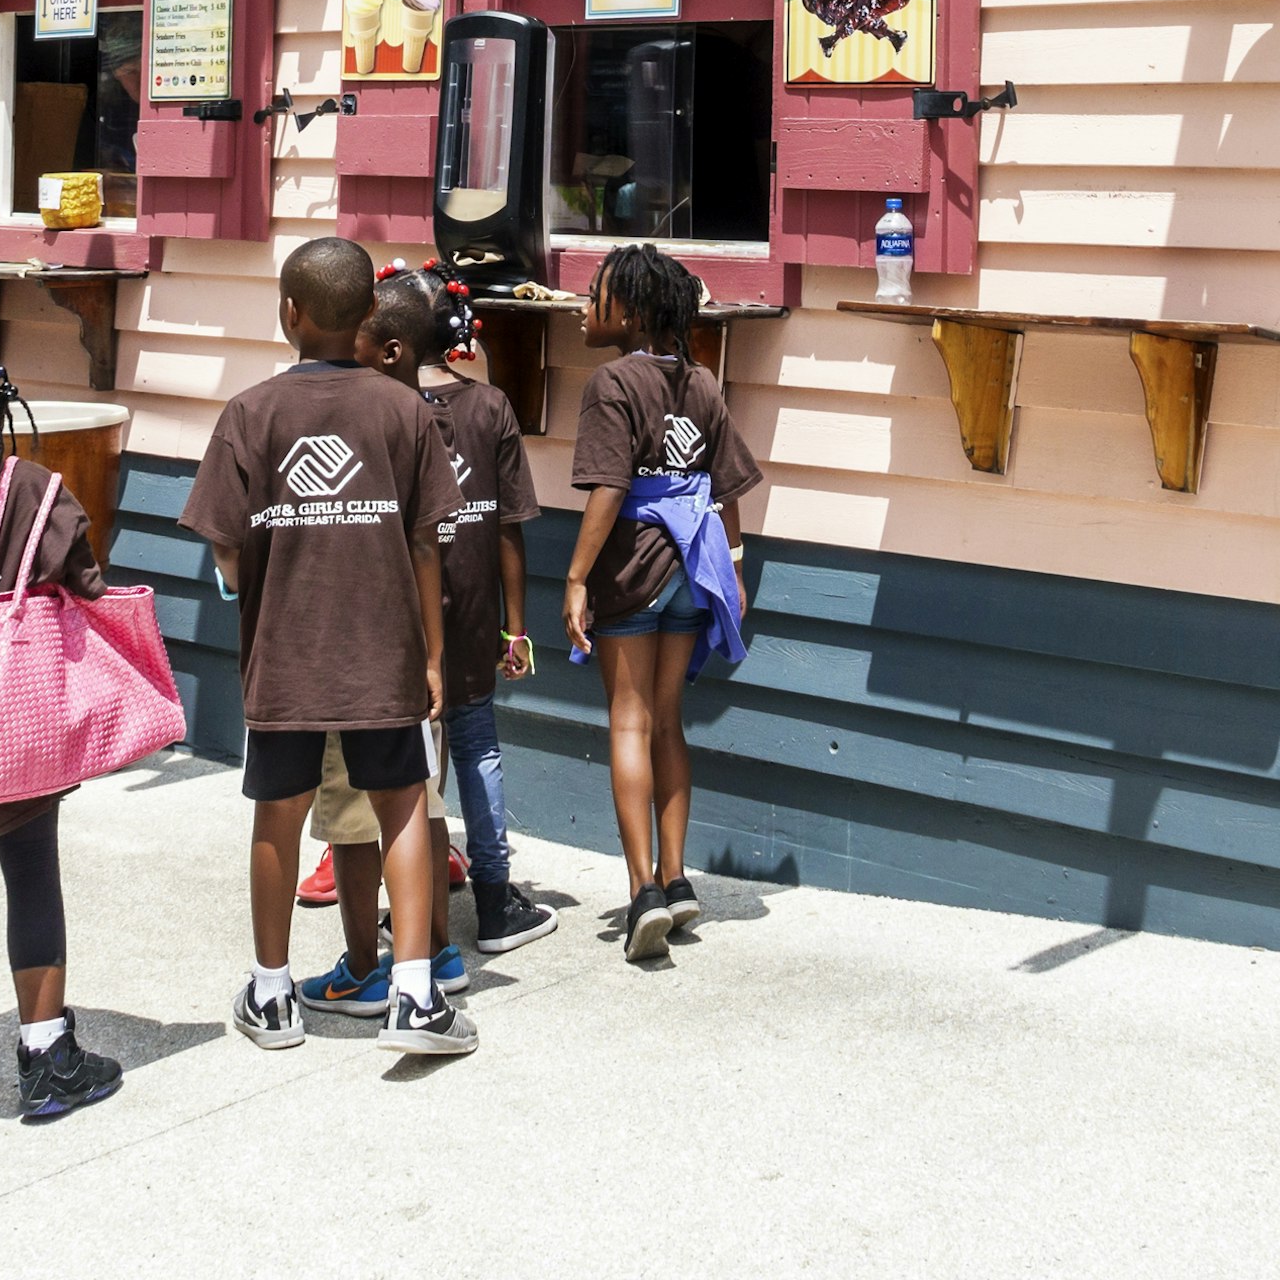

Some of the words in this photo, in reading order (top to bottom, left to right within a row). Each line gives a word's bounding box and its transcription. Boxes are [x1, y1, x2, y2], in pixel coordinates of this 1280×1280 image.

[53, 6, 77, 21] HERE
[880, 240, 910, 249] AQUAFINA
[282, 504, 296, 516] &
[298, 501, 344, 515] GIRLS
[346, 500, 398, 514] CLUBS
[336, 514, 382, 524] FLORIDA
